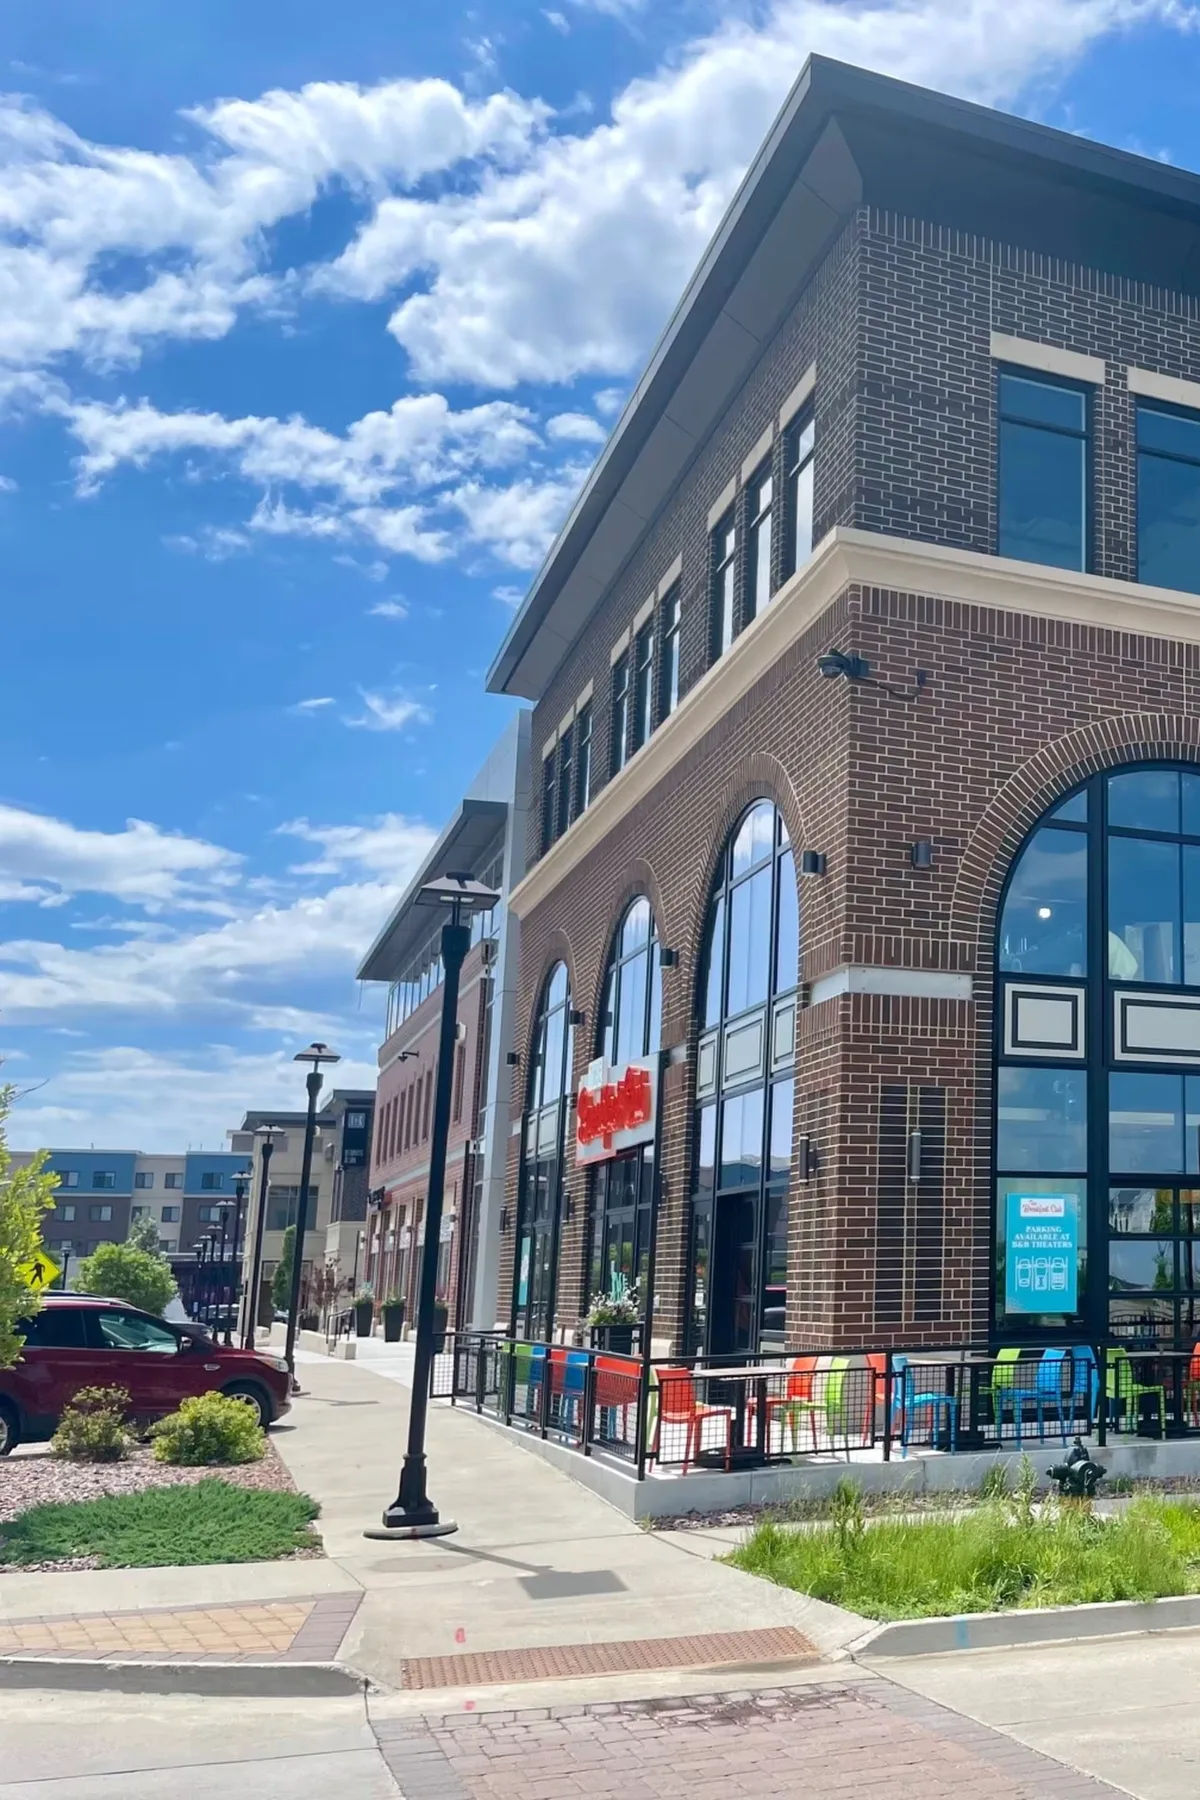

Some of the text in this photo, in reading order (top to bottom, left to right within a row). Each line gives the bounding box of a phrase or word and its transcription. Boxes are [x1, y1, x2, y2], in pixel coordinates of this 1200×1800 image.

[1025, 1225, 1062, 1233] PARKING
[1014, 1233, 1070, 1241] AVAILABLE AT
